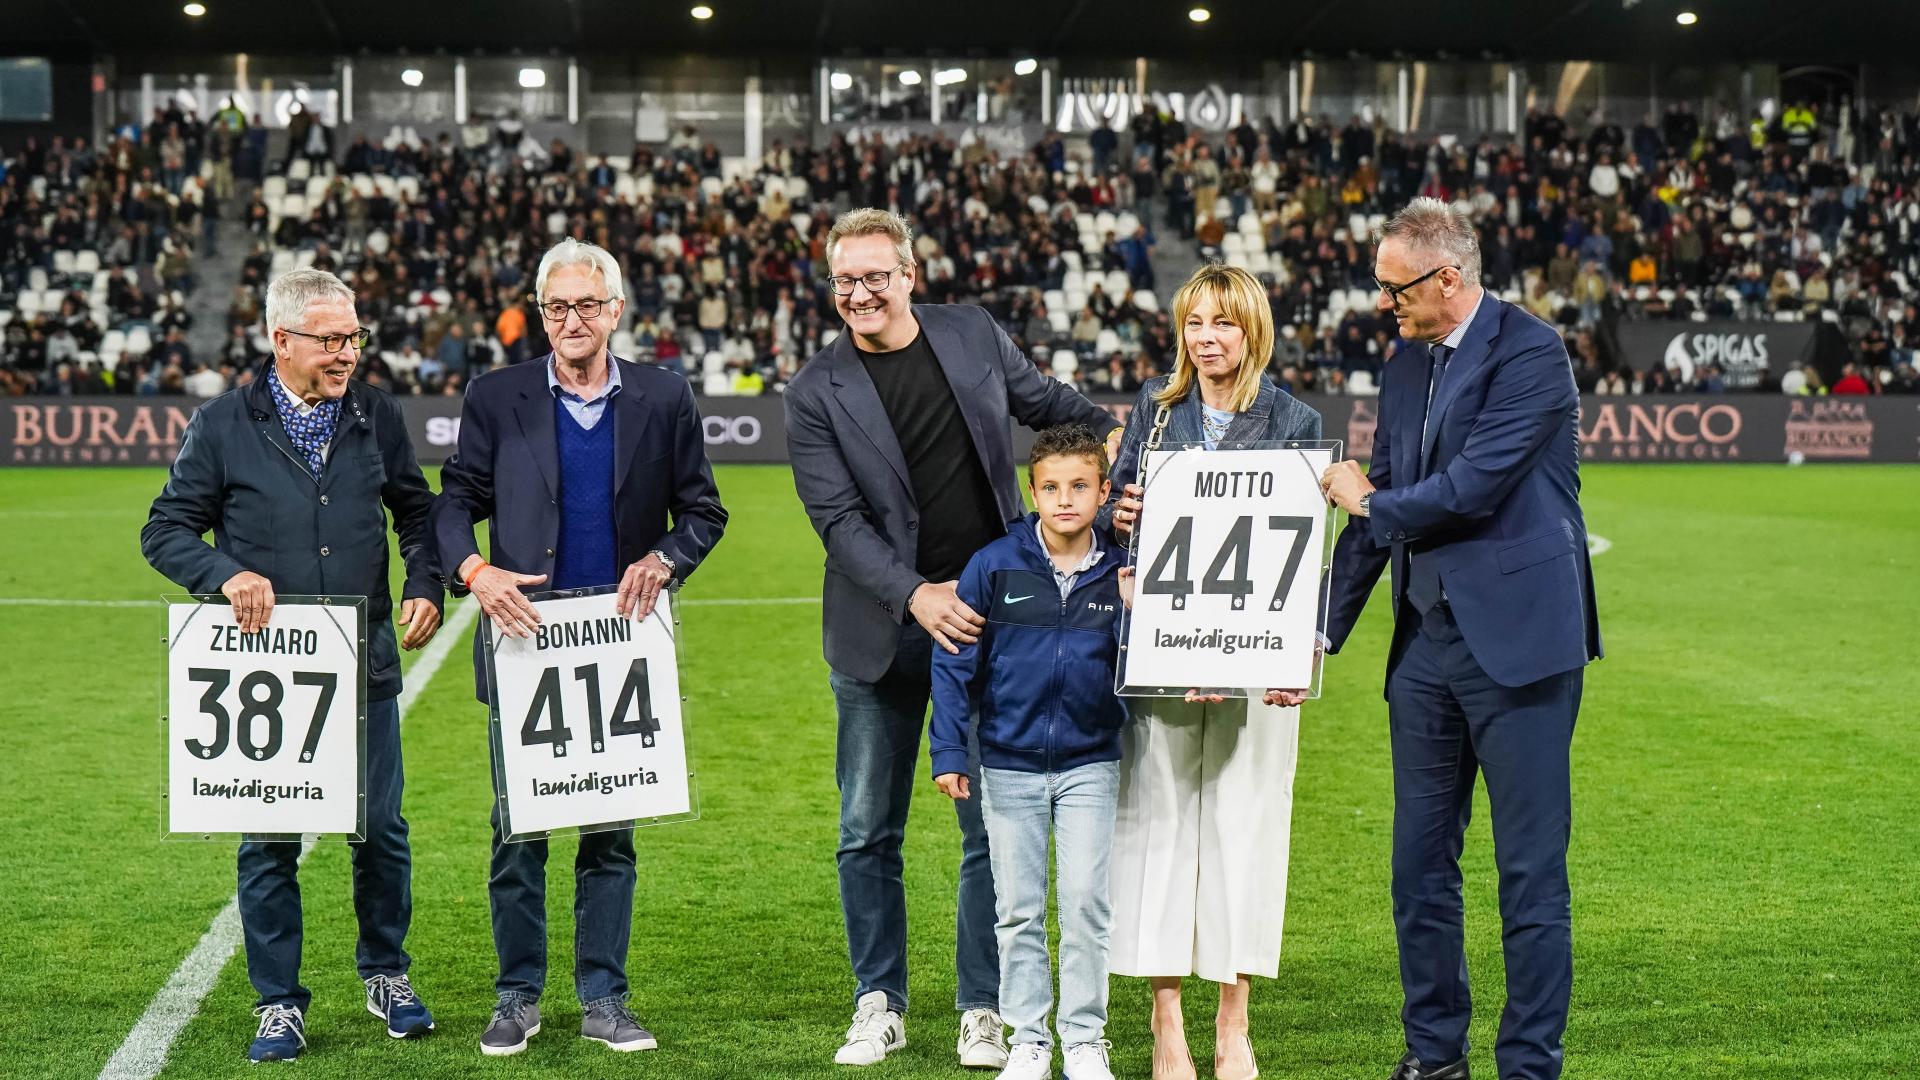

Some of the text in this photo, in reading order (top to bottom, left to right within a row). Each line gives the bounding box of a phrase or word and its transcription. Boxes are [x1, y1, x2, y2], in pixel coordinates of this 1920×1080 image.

[1692, 333, 1769, 368] SPIGAS
[12, 404, 200, 446] BURAN
[1579, 403, 1743, 444] ANCO
[1194, 471, 1273, 498] MOTTO
[1142, 515, 1314, 612] 447
[1088, 602, 1114, 612] AIR
[210, 624, 318, 656] ZENNARO
[536, 617, 632, 651] BONANNI
[184, 667, 338, 763] 387
[520, 657, 661, 758] 414
